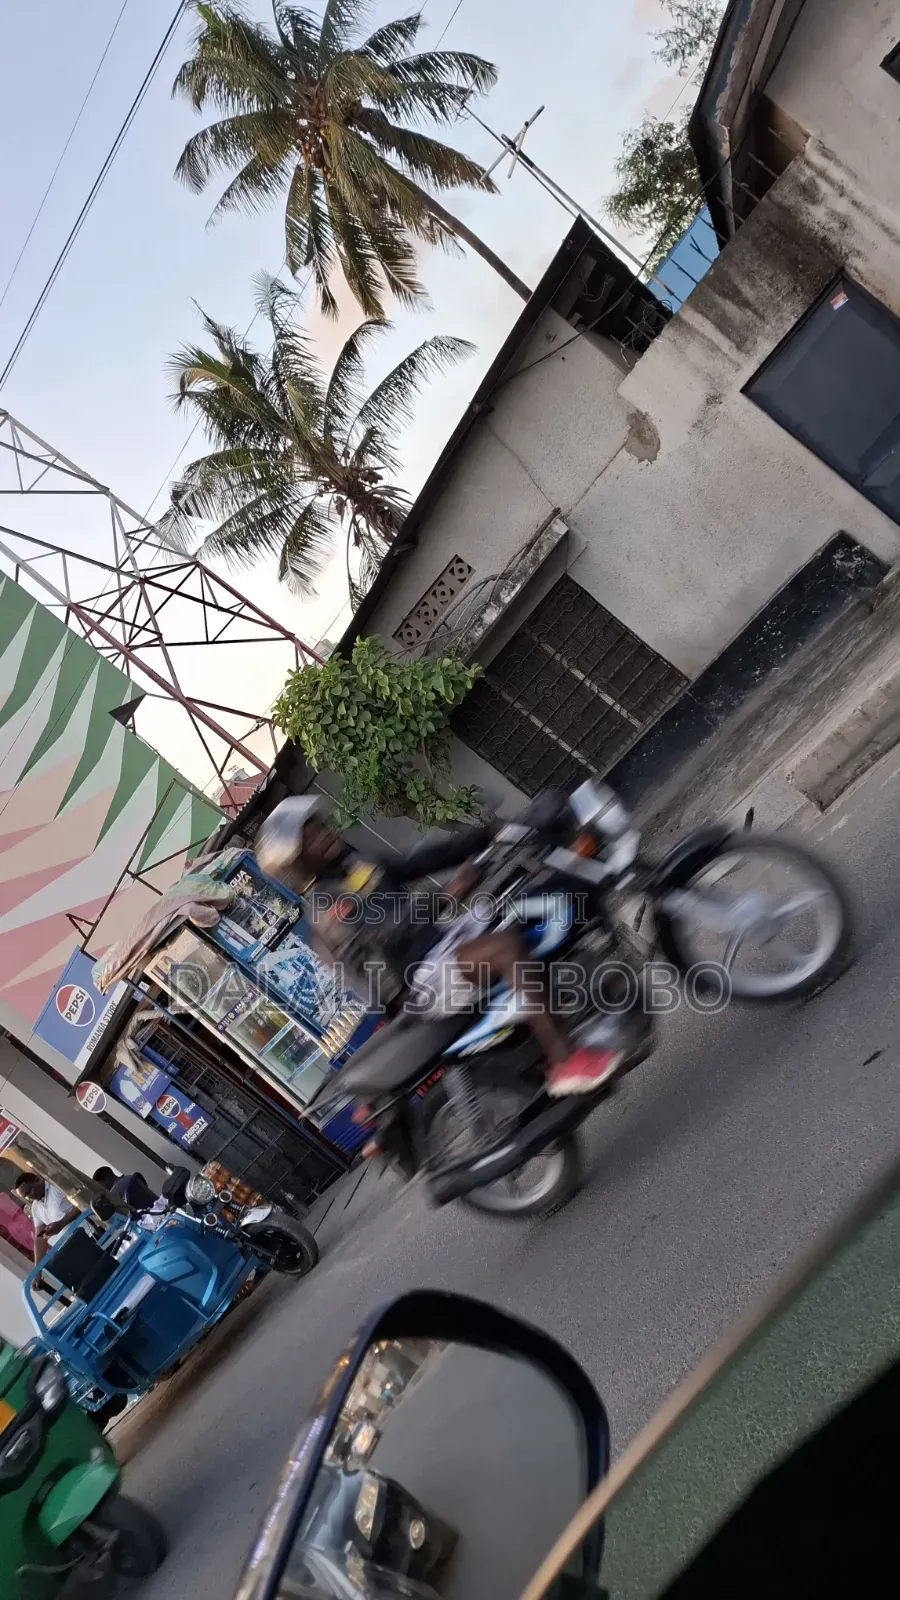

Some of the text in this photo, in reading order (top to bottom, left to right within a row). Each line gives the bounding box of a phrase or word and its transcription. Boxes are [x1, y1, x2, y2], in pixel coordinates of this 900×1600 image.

[65, 989, 86, 1021] PEPSI
[86, 1000, 118, 1052] ROMANIA STORE
[83, 1087, 100, 1108] PEPSI
[160, 1098, 176, 1114] PEPSI
[181, 1115, 205, 1141] THIRSTY
